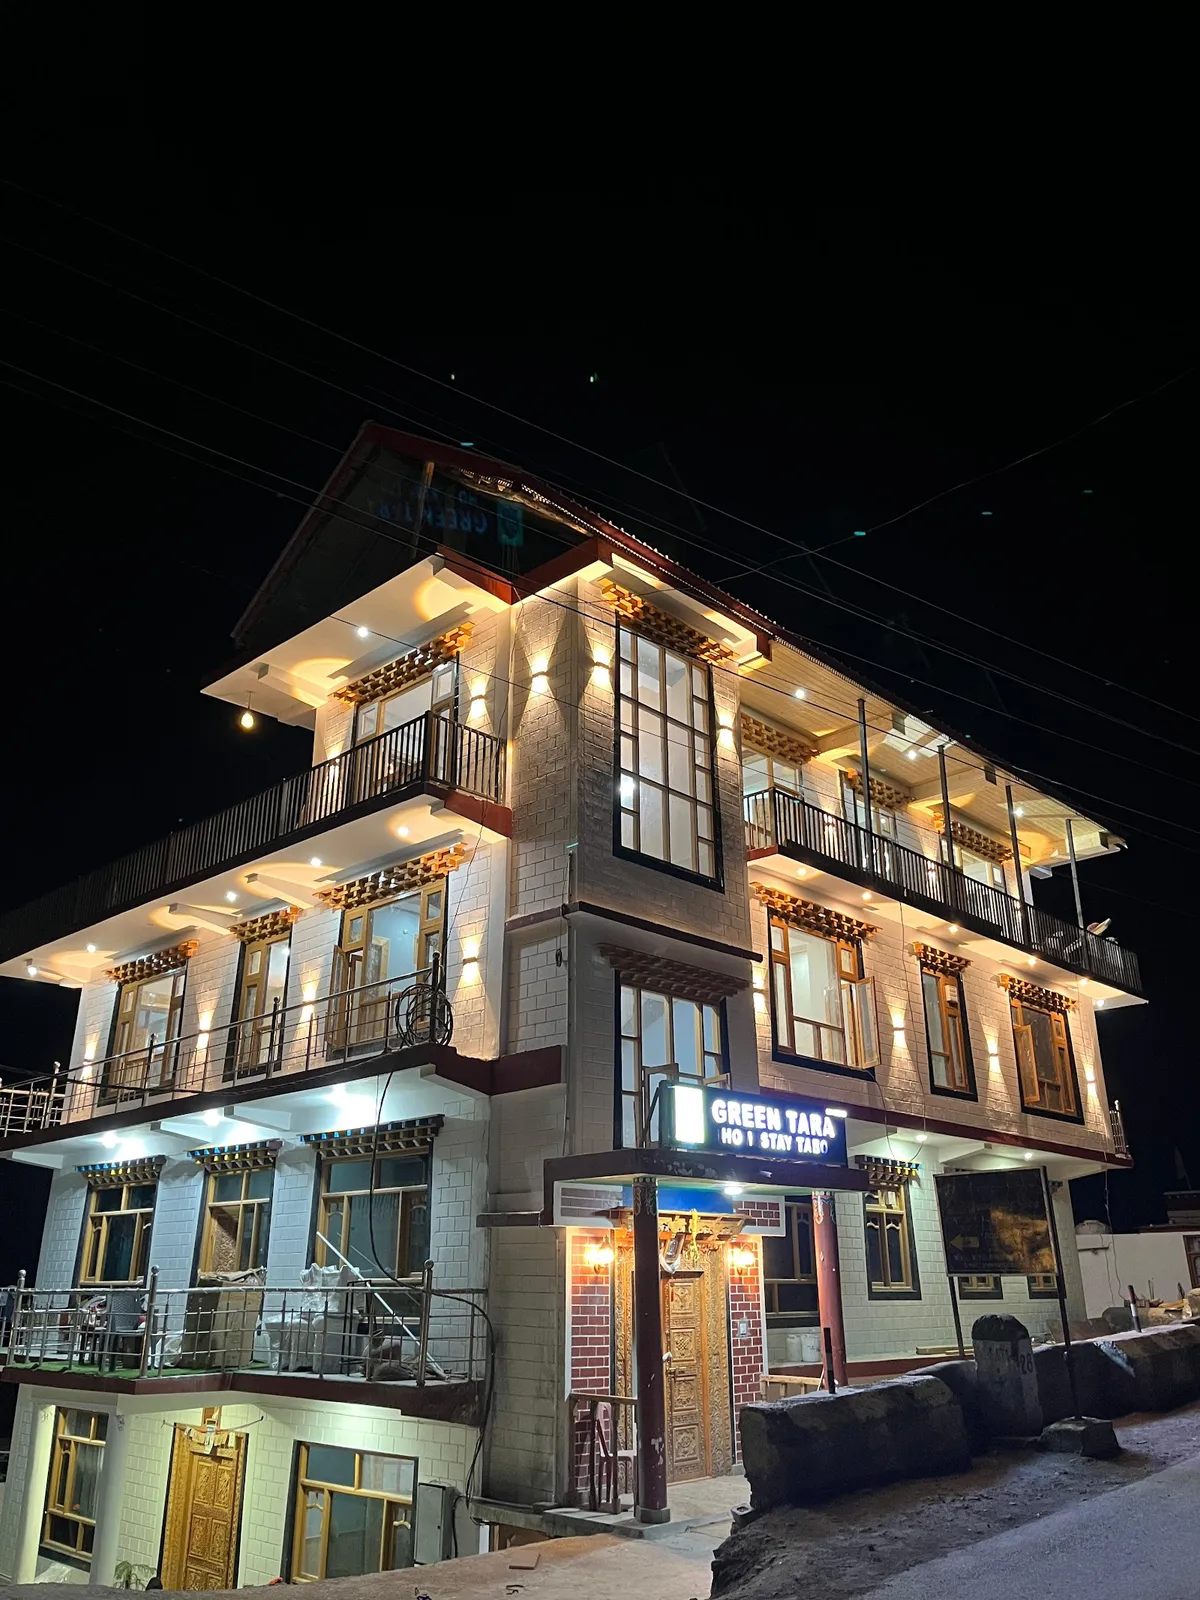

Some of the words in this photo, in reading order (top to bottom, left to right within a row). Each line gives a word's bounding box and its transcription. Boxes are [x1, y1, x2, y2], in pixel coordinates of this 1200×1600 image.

[711, 1099, 781, 1131] GREEN
[785, 1110, 836, 1138] TARA
[760, 1131, 792, 1151] STAY
[796, 1136, 828, 1154] TABO
[1020, 1353, 1034, 1375] 28
